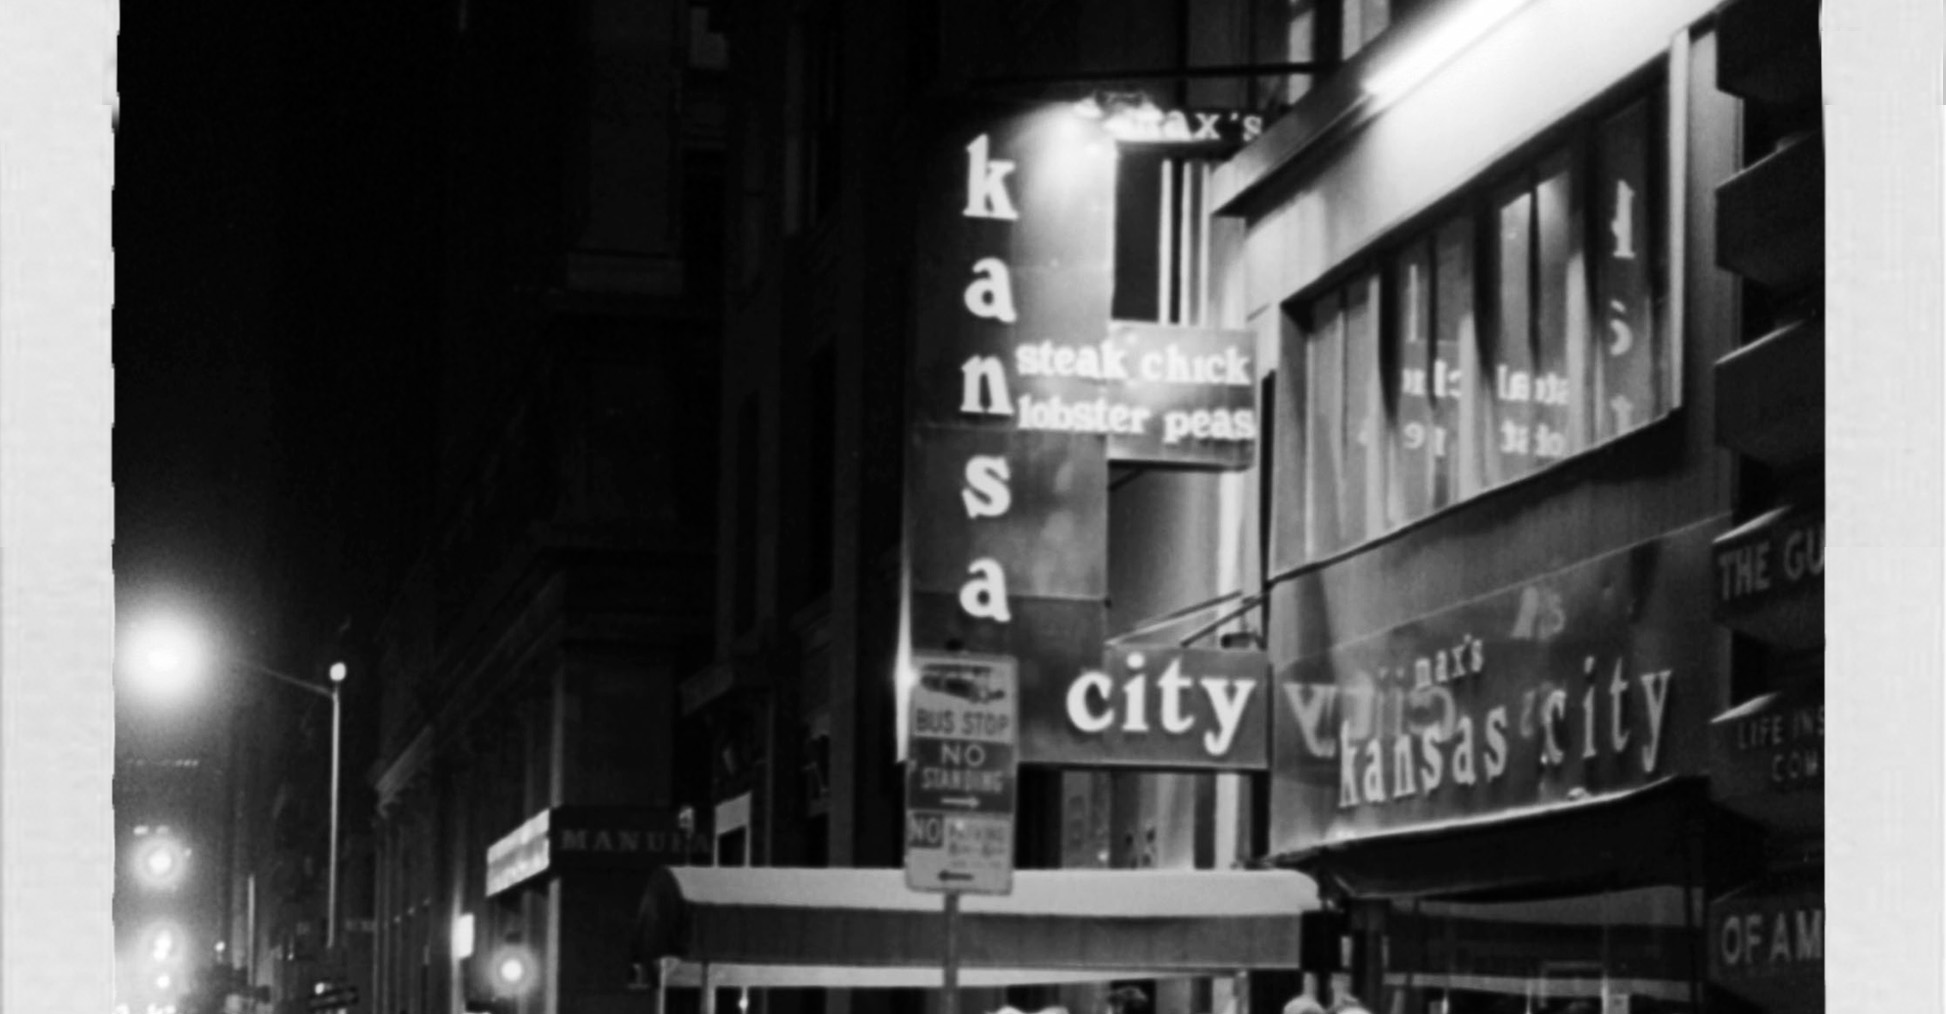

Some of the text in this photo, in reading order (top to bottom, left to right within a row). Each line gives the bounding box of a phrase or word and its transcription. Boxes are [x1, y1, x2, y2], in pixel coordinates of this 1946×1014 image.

[1118, 108, 1263, 142] ax's
[1015, 340, 1251, 386] steak chick
[1017, 393, 1256, 444] lobster peas
[1718, 541, 1770, 600] THE
[1414, 633, 1484, 690] max's
[916, 708, 1009, 736] BUS STOP
[1065, 651, 1257, 756] city
[941, 743, 986, 768] NO
[1339, 655, 1673, 808] kansas city
[1737, 714, 1783, 750] LIFE
[908, 813, 941, 844] NO
[1720, 913, 1762, 966] OF
